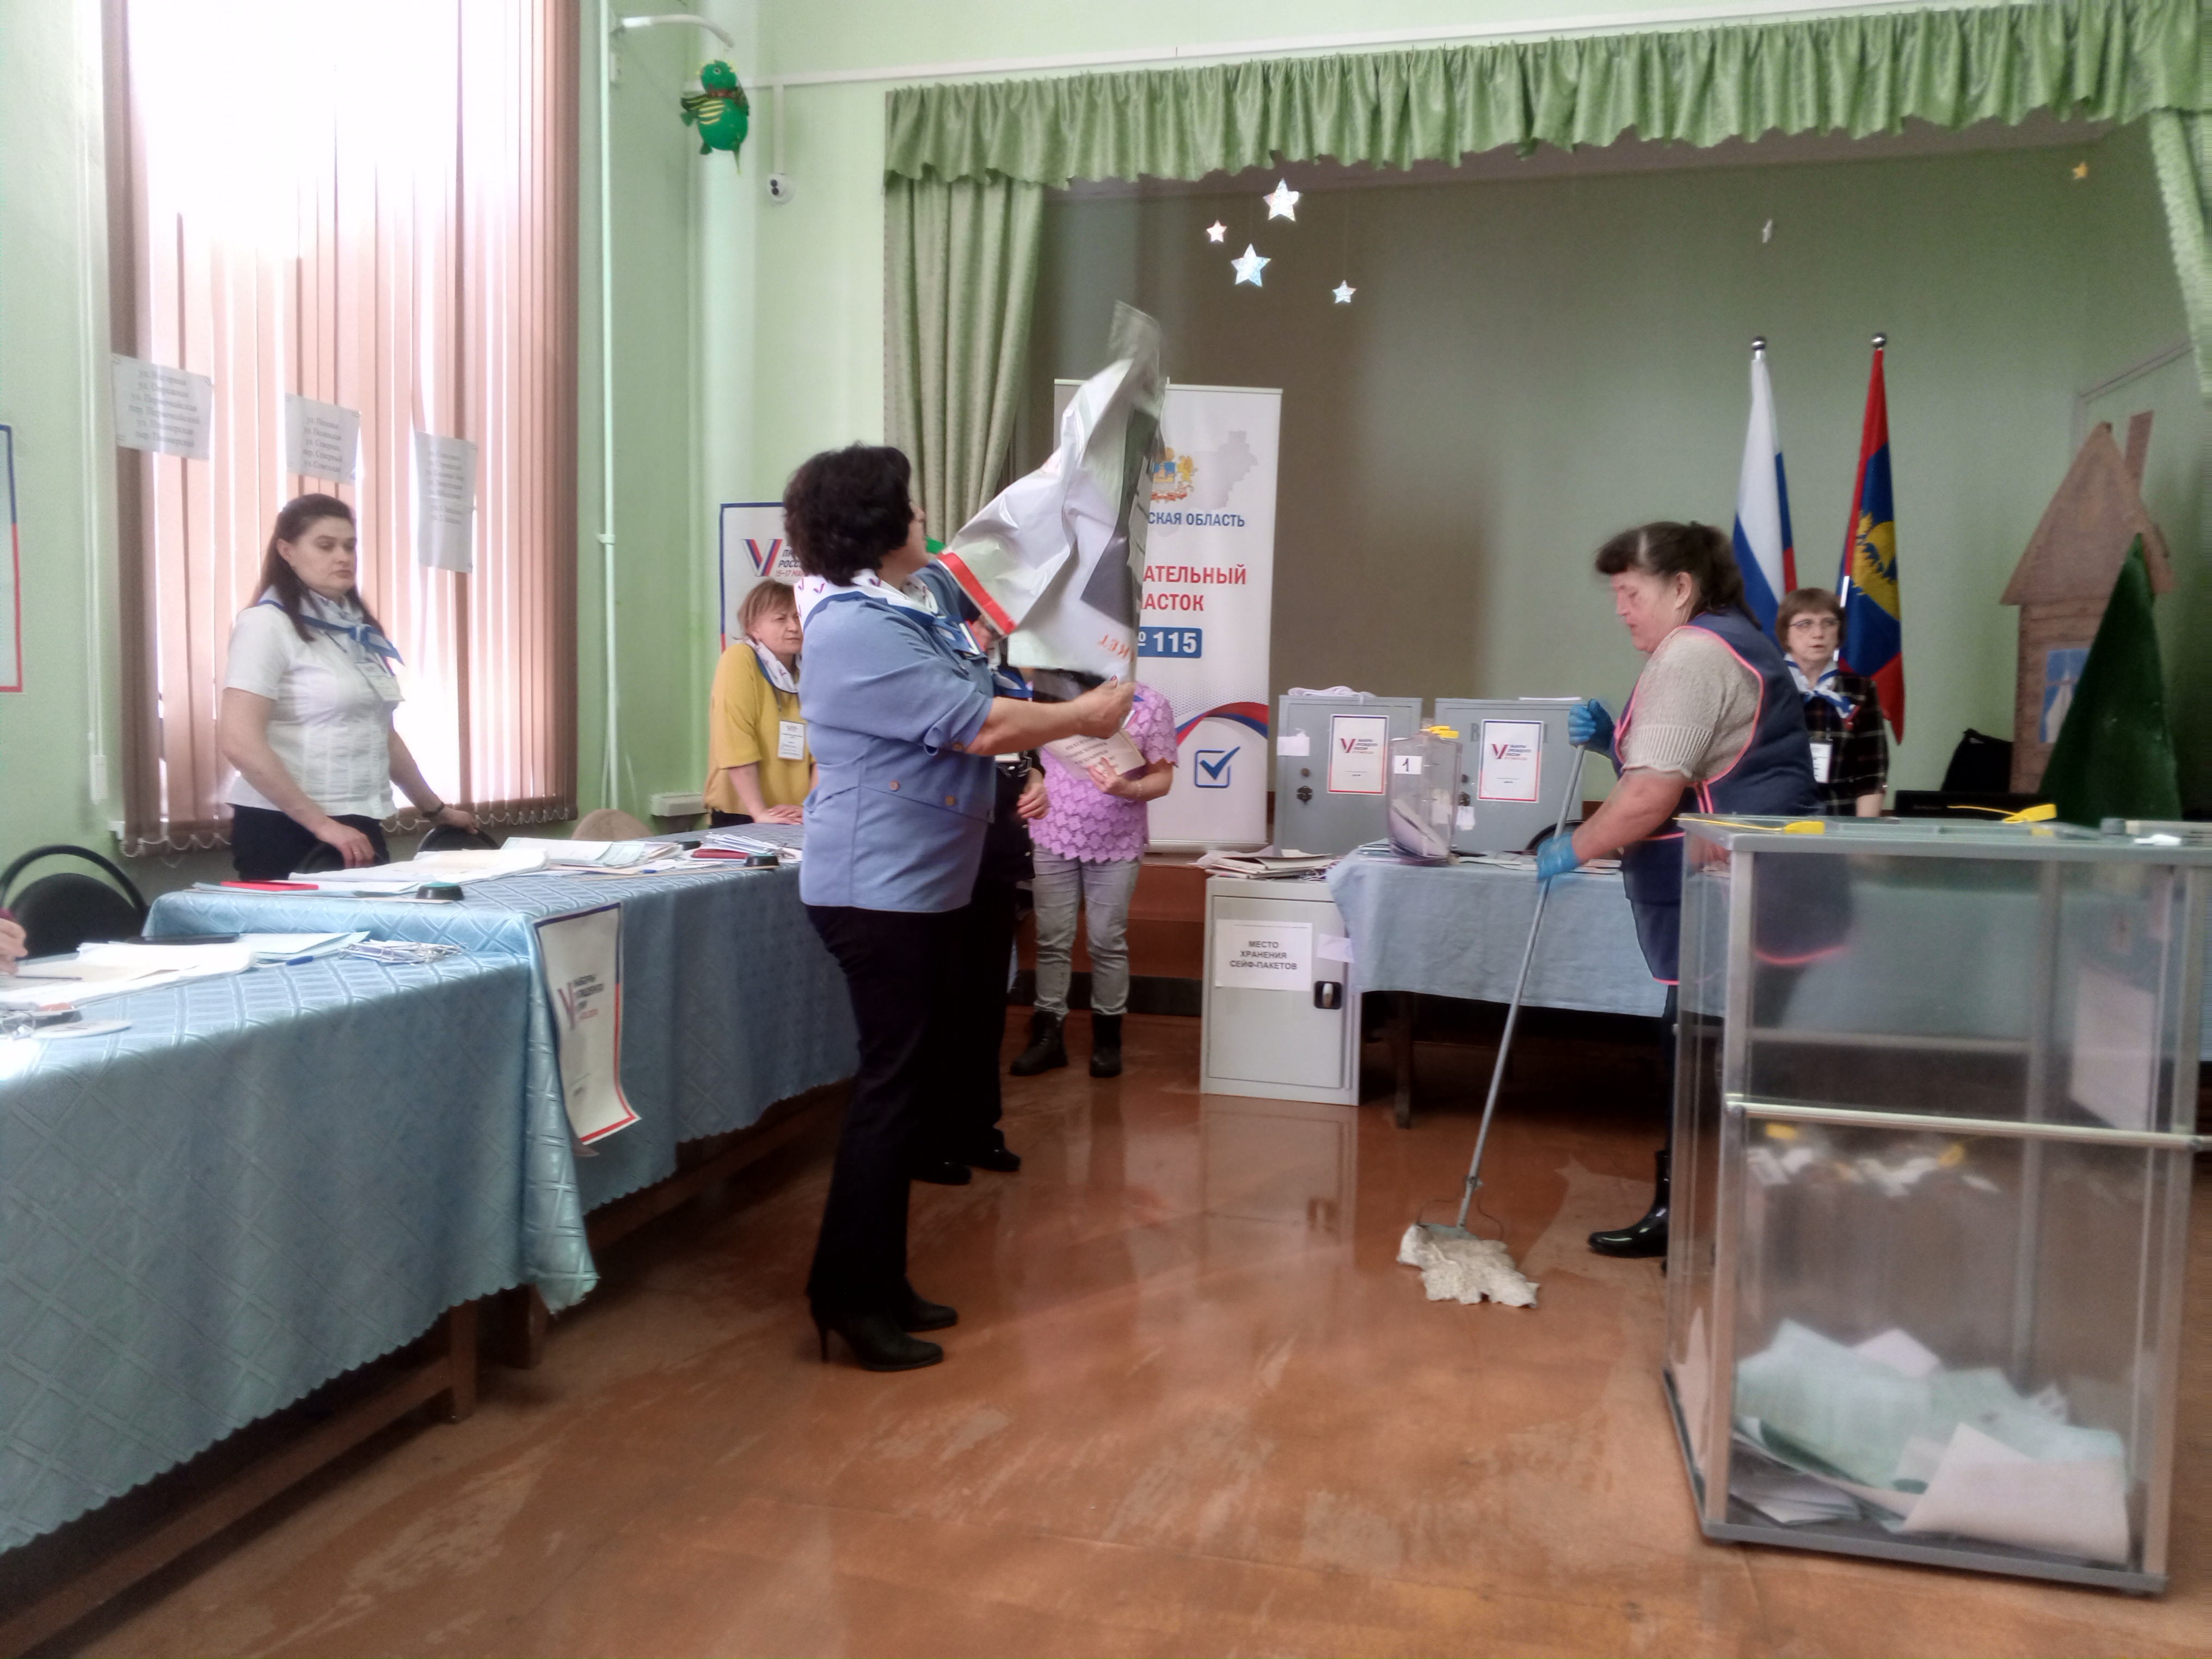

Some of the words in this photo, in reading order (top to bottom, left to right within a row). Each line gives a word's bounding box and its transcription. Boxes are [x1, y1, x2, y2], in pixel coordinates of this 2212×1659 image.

[1186, 513, 1245, 527] ОБЛАСТЬ
[1144, 564, 1246, 585] АТЕЛЬНЫЙ
[1141, 593, 1205, 612] АСТОК
[1152, 631, 1198, 654] 115
[1401, 758, 1410, 772] 1
[1249, 941, 1279, 949] МЕСТО
[1240, 950, 1287, 960] ХРАНЕНИЯ
[1230, 960, 1298, 970] СЕЙФ-ПАКЕТОВ
